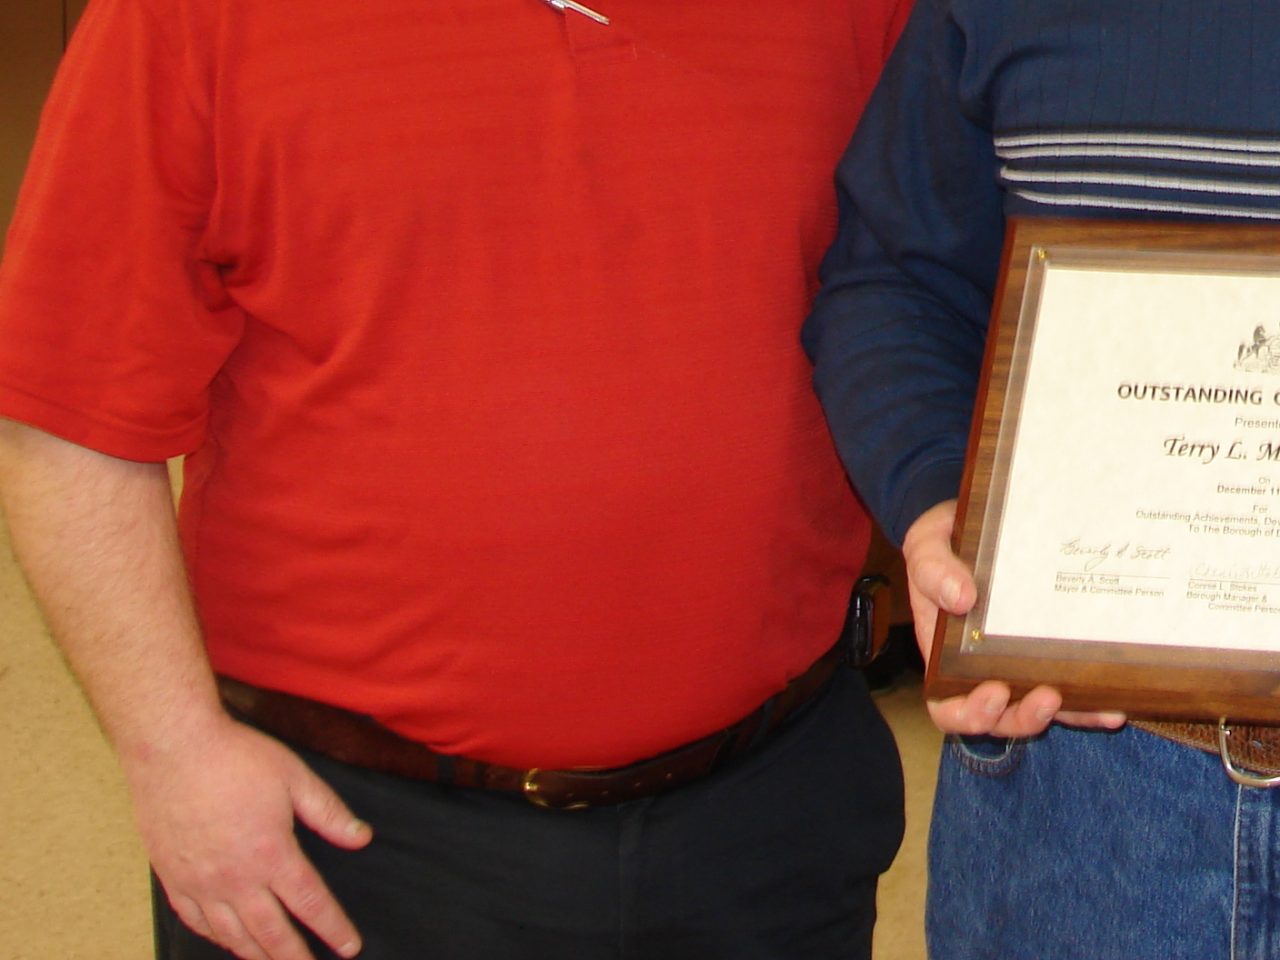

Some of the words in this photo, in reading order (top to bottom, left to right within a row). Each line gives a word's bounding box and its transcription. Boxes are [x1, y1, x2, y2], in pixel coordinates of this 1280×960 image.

[1117, 383, 1263, 406] OUTSTANDING
[1163, 434, 1220, 465] Terry
[1224, 441, 1248, 460] L.
[1217, 484, 1267, 496] December
[1135, 509, 1191, 523] Outstanding
[1252, 504, 1268, 514] For
[1189, 524, 1200, 534] To
[1203, 524, 1221, 534] The
[1222, 526, 1263, 538] Borough
[1264, 527, 1275, 537] of
